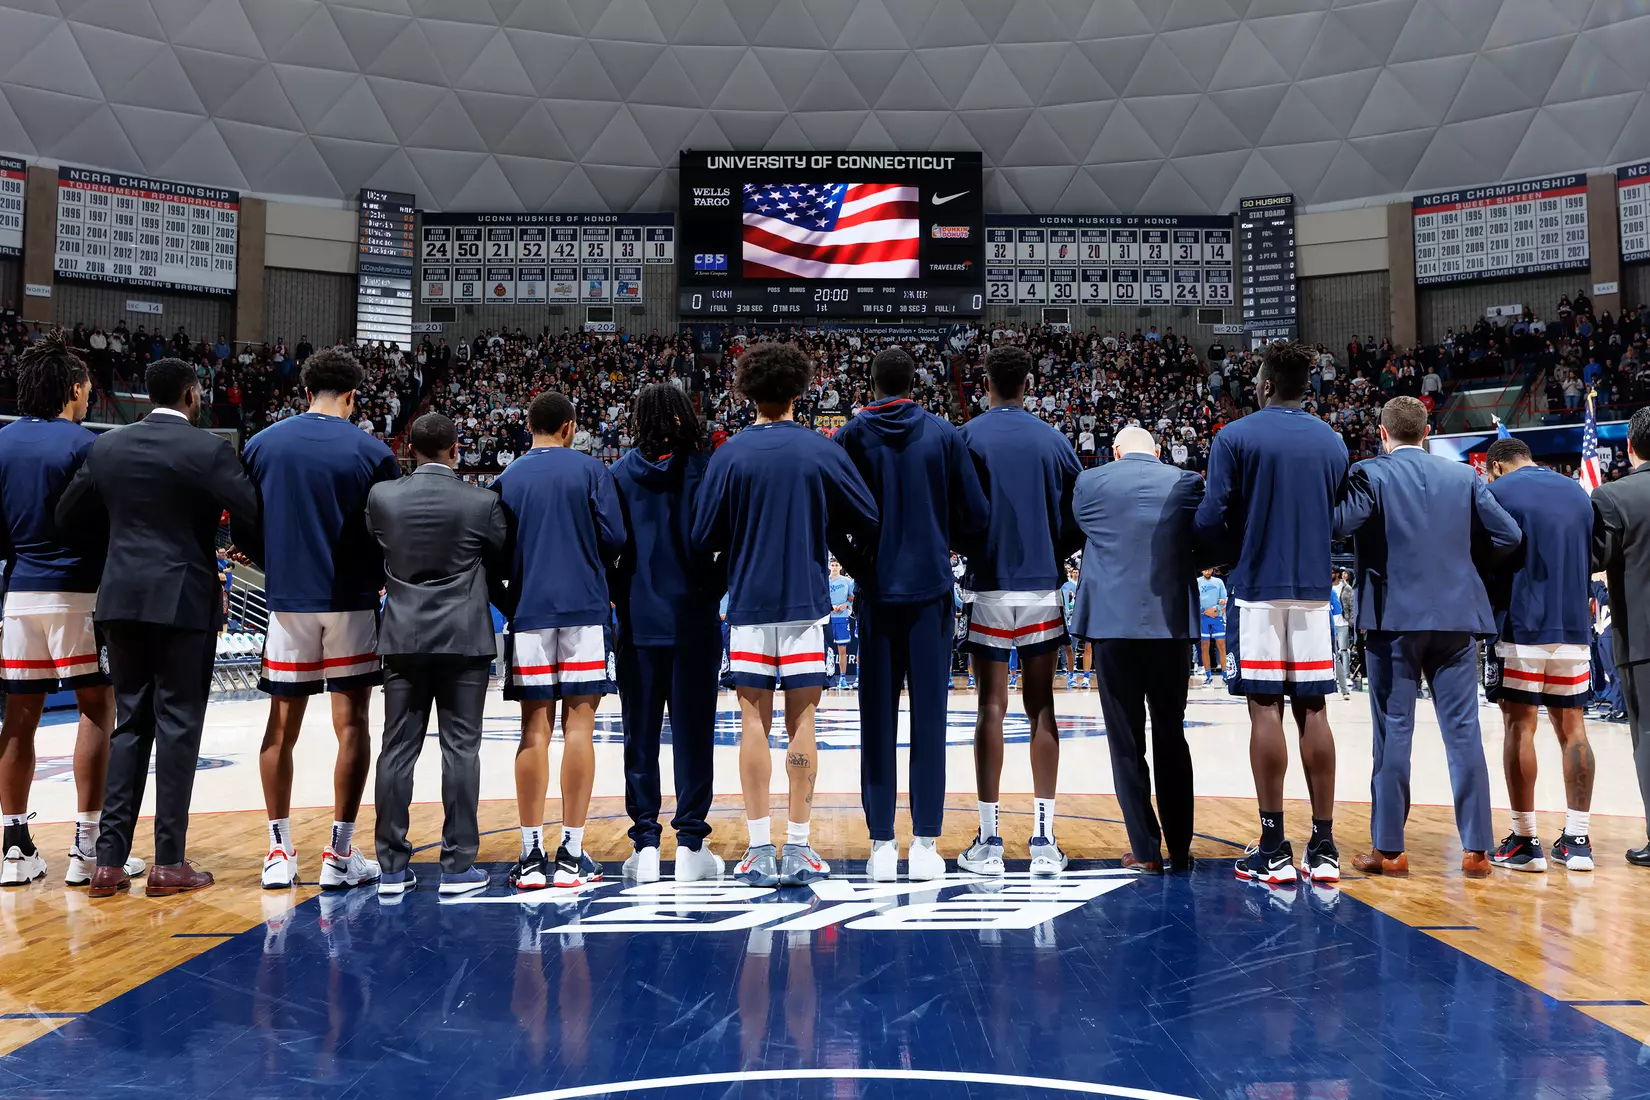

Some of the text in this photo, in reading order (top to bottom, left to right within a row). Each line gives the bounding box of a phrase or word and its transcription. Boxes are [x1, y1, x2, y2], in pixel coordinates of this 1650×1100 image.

[708, 156, 955, 170] UNIVERSITY OF CONNECTICUT
[2, 180, 20, 193] 1998
[70, 170, 229, 200] NCAA CHAMPIONSHIP
[1424, 177, 1575, 205] NCAA CHAMPIONSHIP
[68, 181, 230, 208] TOURNAMENT APPEARANCES
[1623, 188, 1640, 200] 1991
[62, 190, 234, 222] 1989 1991 1992 1993 1994 1995
[694, 198, 730, 206] FARGO
[1256, 197, 1291, 206] HUSKIES
[1456, 199, 1490, 209] SWEET
[1418, 197, 1583, 227] 1991 1994 1996 1997 1999
[1624, 205, 1642, 217] 2001
[62, 207, 234, 239] 1996 1997 1999 2001 2002
[1442, 217, 1558, 240] 2001 2003 2005
[87, 227, 184, 249] 2004 2007
[1418, 230, 1584, 258] 2007 2011 2012 2013
[87, 244, 208, 267] 2011 2014 2015
[426, 243, 447, 256] 24
[458, 243, 479, 256] 50
[492, 243, 508, 256] 21
[523, 243, 542, 256] 52
[554, 243, 574, 256] 42
[588, 243, 603, 257] 25
[622, 243, 633, 257] 33
[655, 243, 664, 257] 10
[994, 244, 1006, 258] 32
[1029, 244, 1034, 258] 3
[1088, 245, 1100, 258] 20
[1120, 245, 1130, 258] 31
[1149, 245, 1161, 258] 23
[1180, 245, 1192, 259] 31
[1211, 245, 1224, 259] 14
[694, 254, 724, 263] CBS
[1443, 246, 1584, 271] 2015 2017 2021
[140, 265, 156, 276] 2021
[1418, 260, 1588, 284] CONNECTICUT WOMEN'S BASKETBALL
[60, 271, 232, 295] CONNECTICUT WOMEN'S BASKETBALL
[814, 289, 848, 301] 20:00
[991, 284, 1009, 297] 23
[1028, 284, 1036, 297] 4
[1055, 284, 1071, 297] 30
[1090, 284, 1098, 298] 3
[1116, 284, 1134, 298] CD
[1150, 284, 1162, 298] 15
[1177, 285, 1198, 298] 24
[1209, 285, 1228, 298] 33
[692, 294, 702, 309] 0
[973, 295, 981, 309] 0
[1262, 818, 1274, 827] 23
